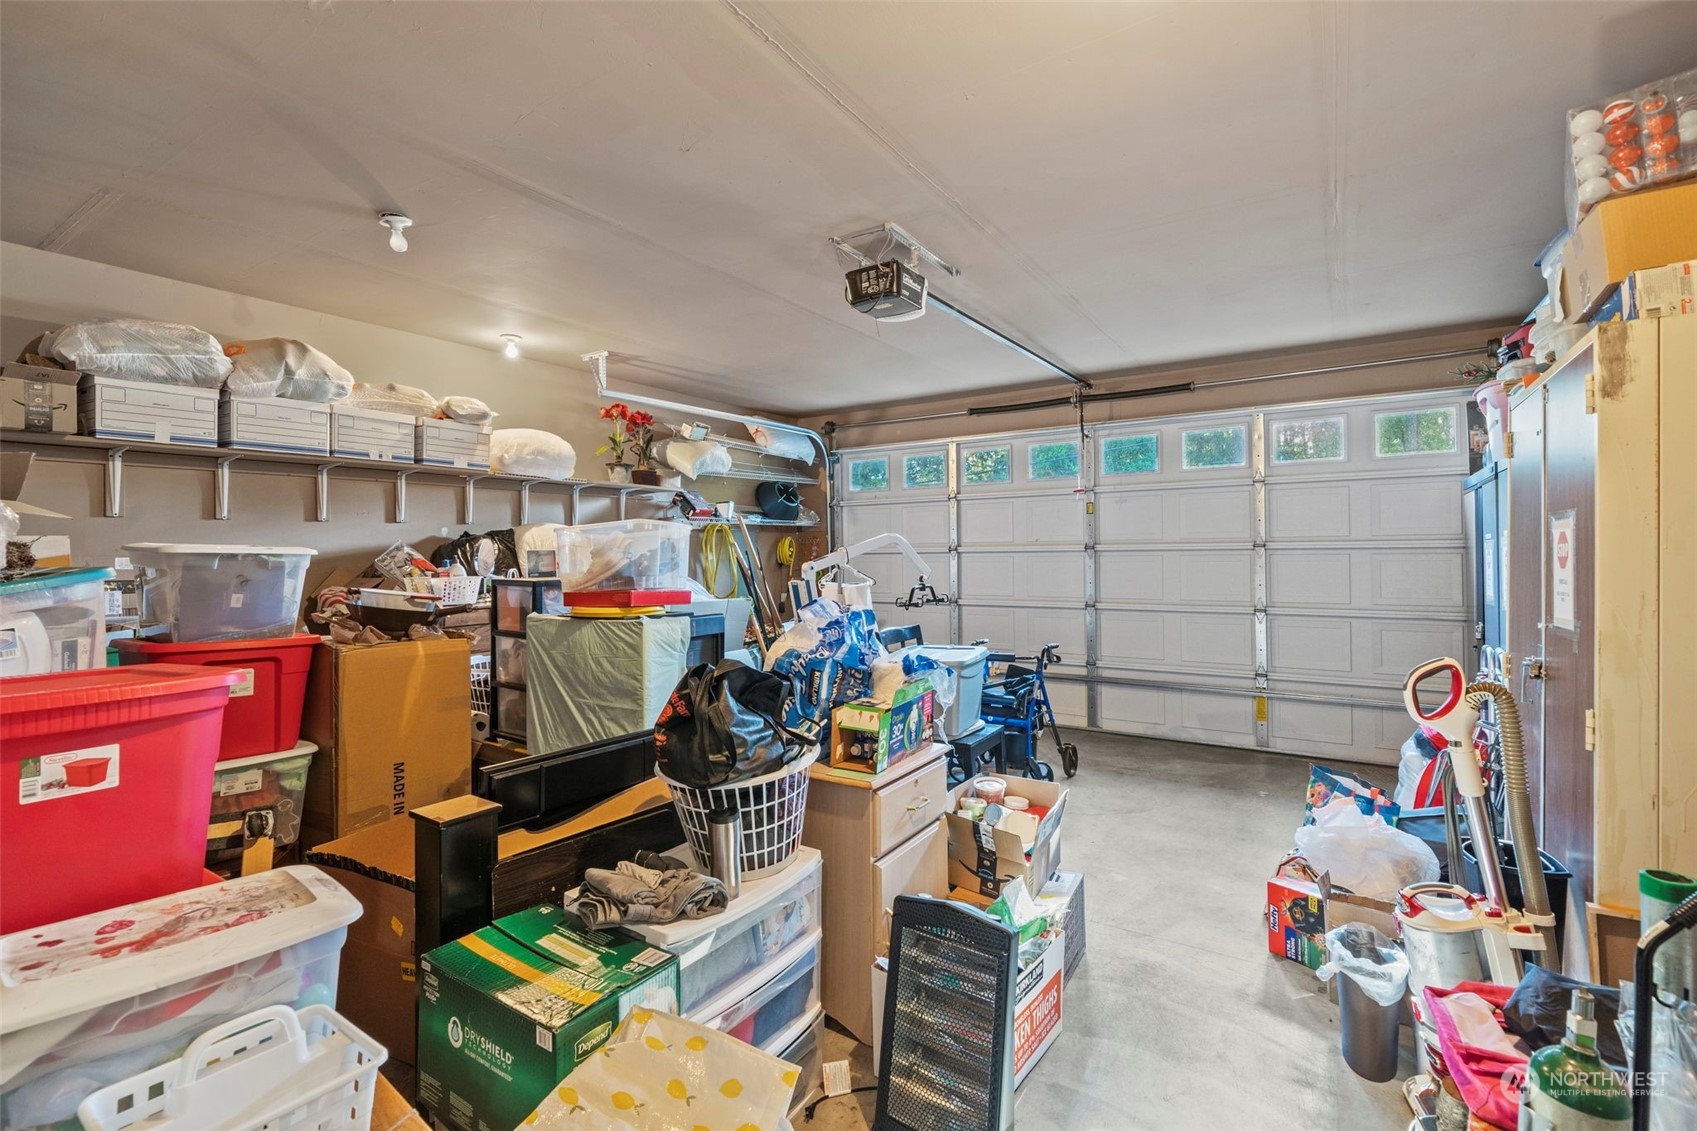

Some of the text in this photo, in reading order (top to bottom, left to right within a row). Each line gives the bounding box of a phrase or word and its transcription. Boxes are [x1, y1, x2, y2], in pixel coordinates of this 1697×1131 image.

[811, 671, 821, 706] KIRKLAND
[393, 762, 405, 816] MADE IN
[1016, 962, 1044, 995] KIRKLAND
[1014, 984, 1058, 1051] KEN THIGHS
[464, 1026, 513, 1065] DRYSHIELD
[464, 1038, 512, 1072] TECHNOLOGY
[577, 1027, 609, 1055] Depend
